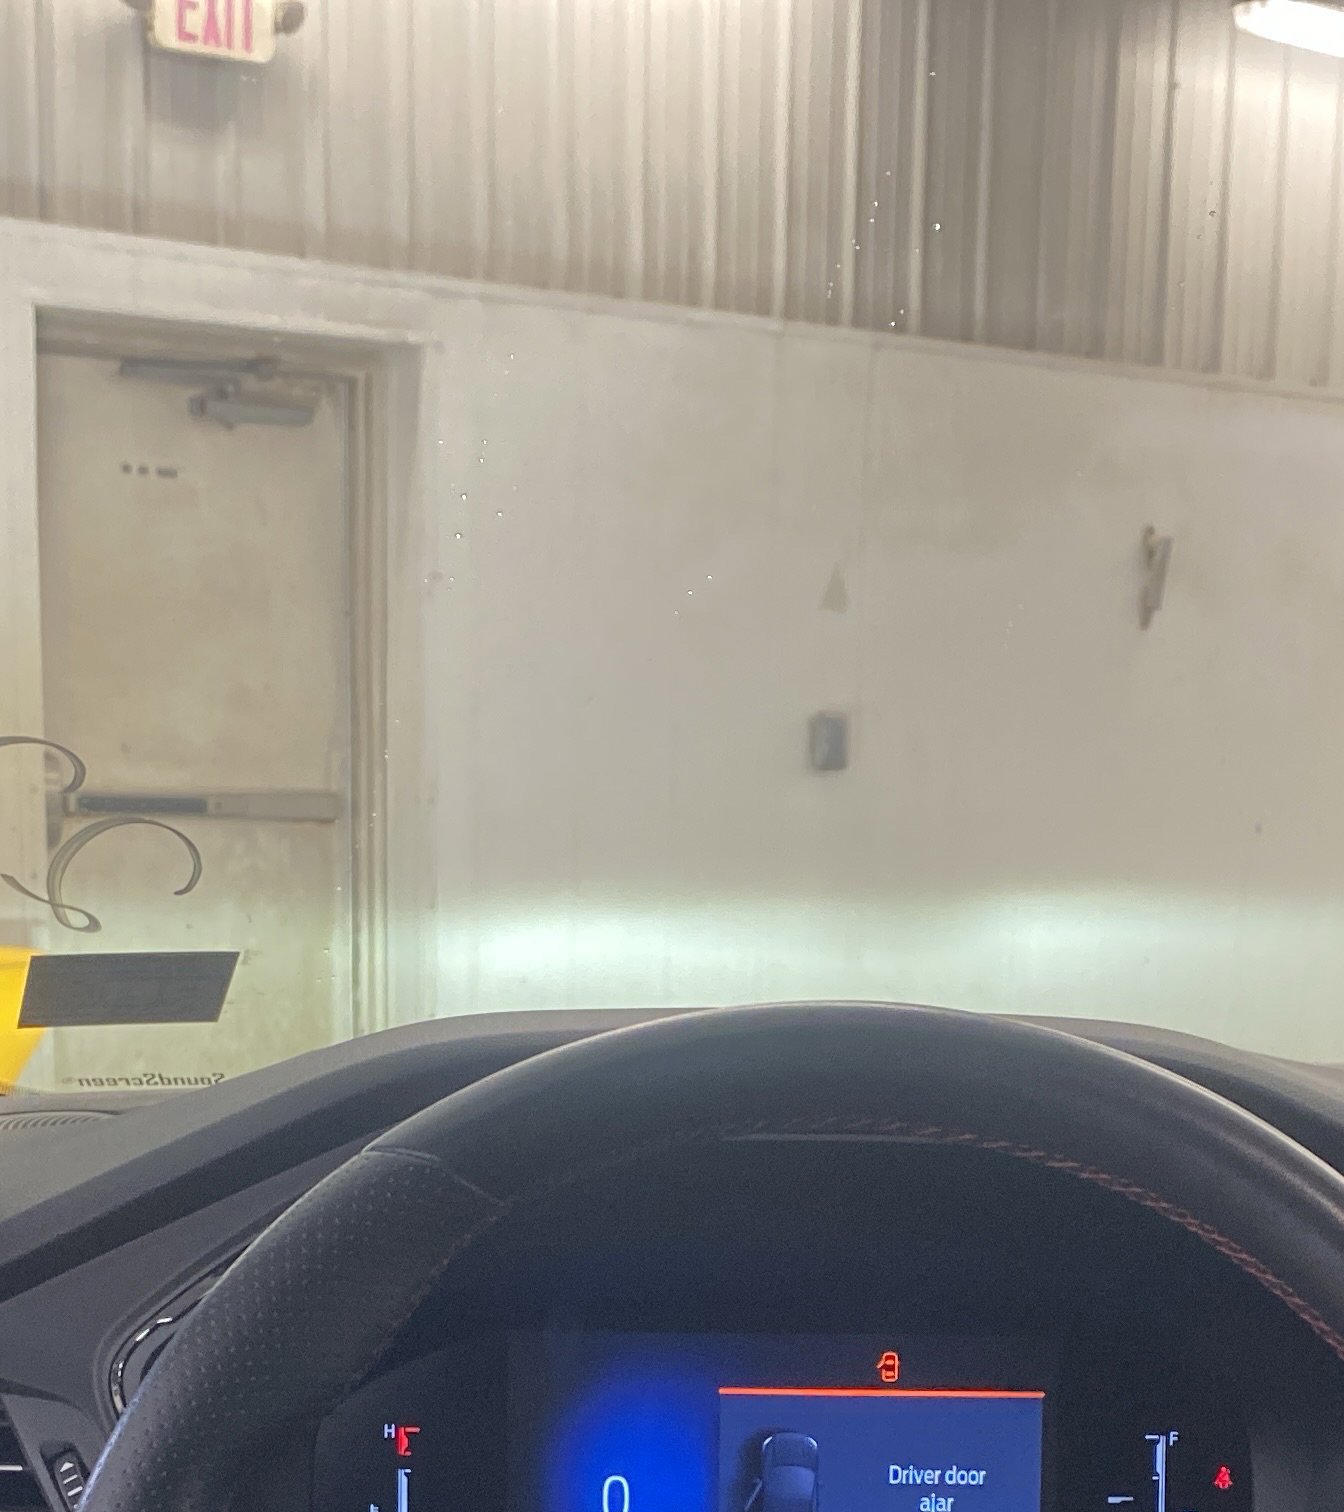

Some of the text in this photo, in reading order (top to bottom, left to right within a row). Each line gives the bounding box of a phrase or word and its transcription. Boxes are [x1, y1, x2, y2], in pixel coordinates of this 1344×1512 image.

[383, 1423, 396, 1439] H
[1168, 1430, 1180, 1447] F
[888, 1464, 987, 1486] Driver door
